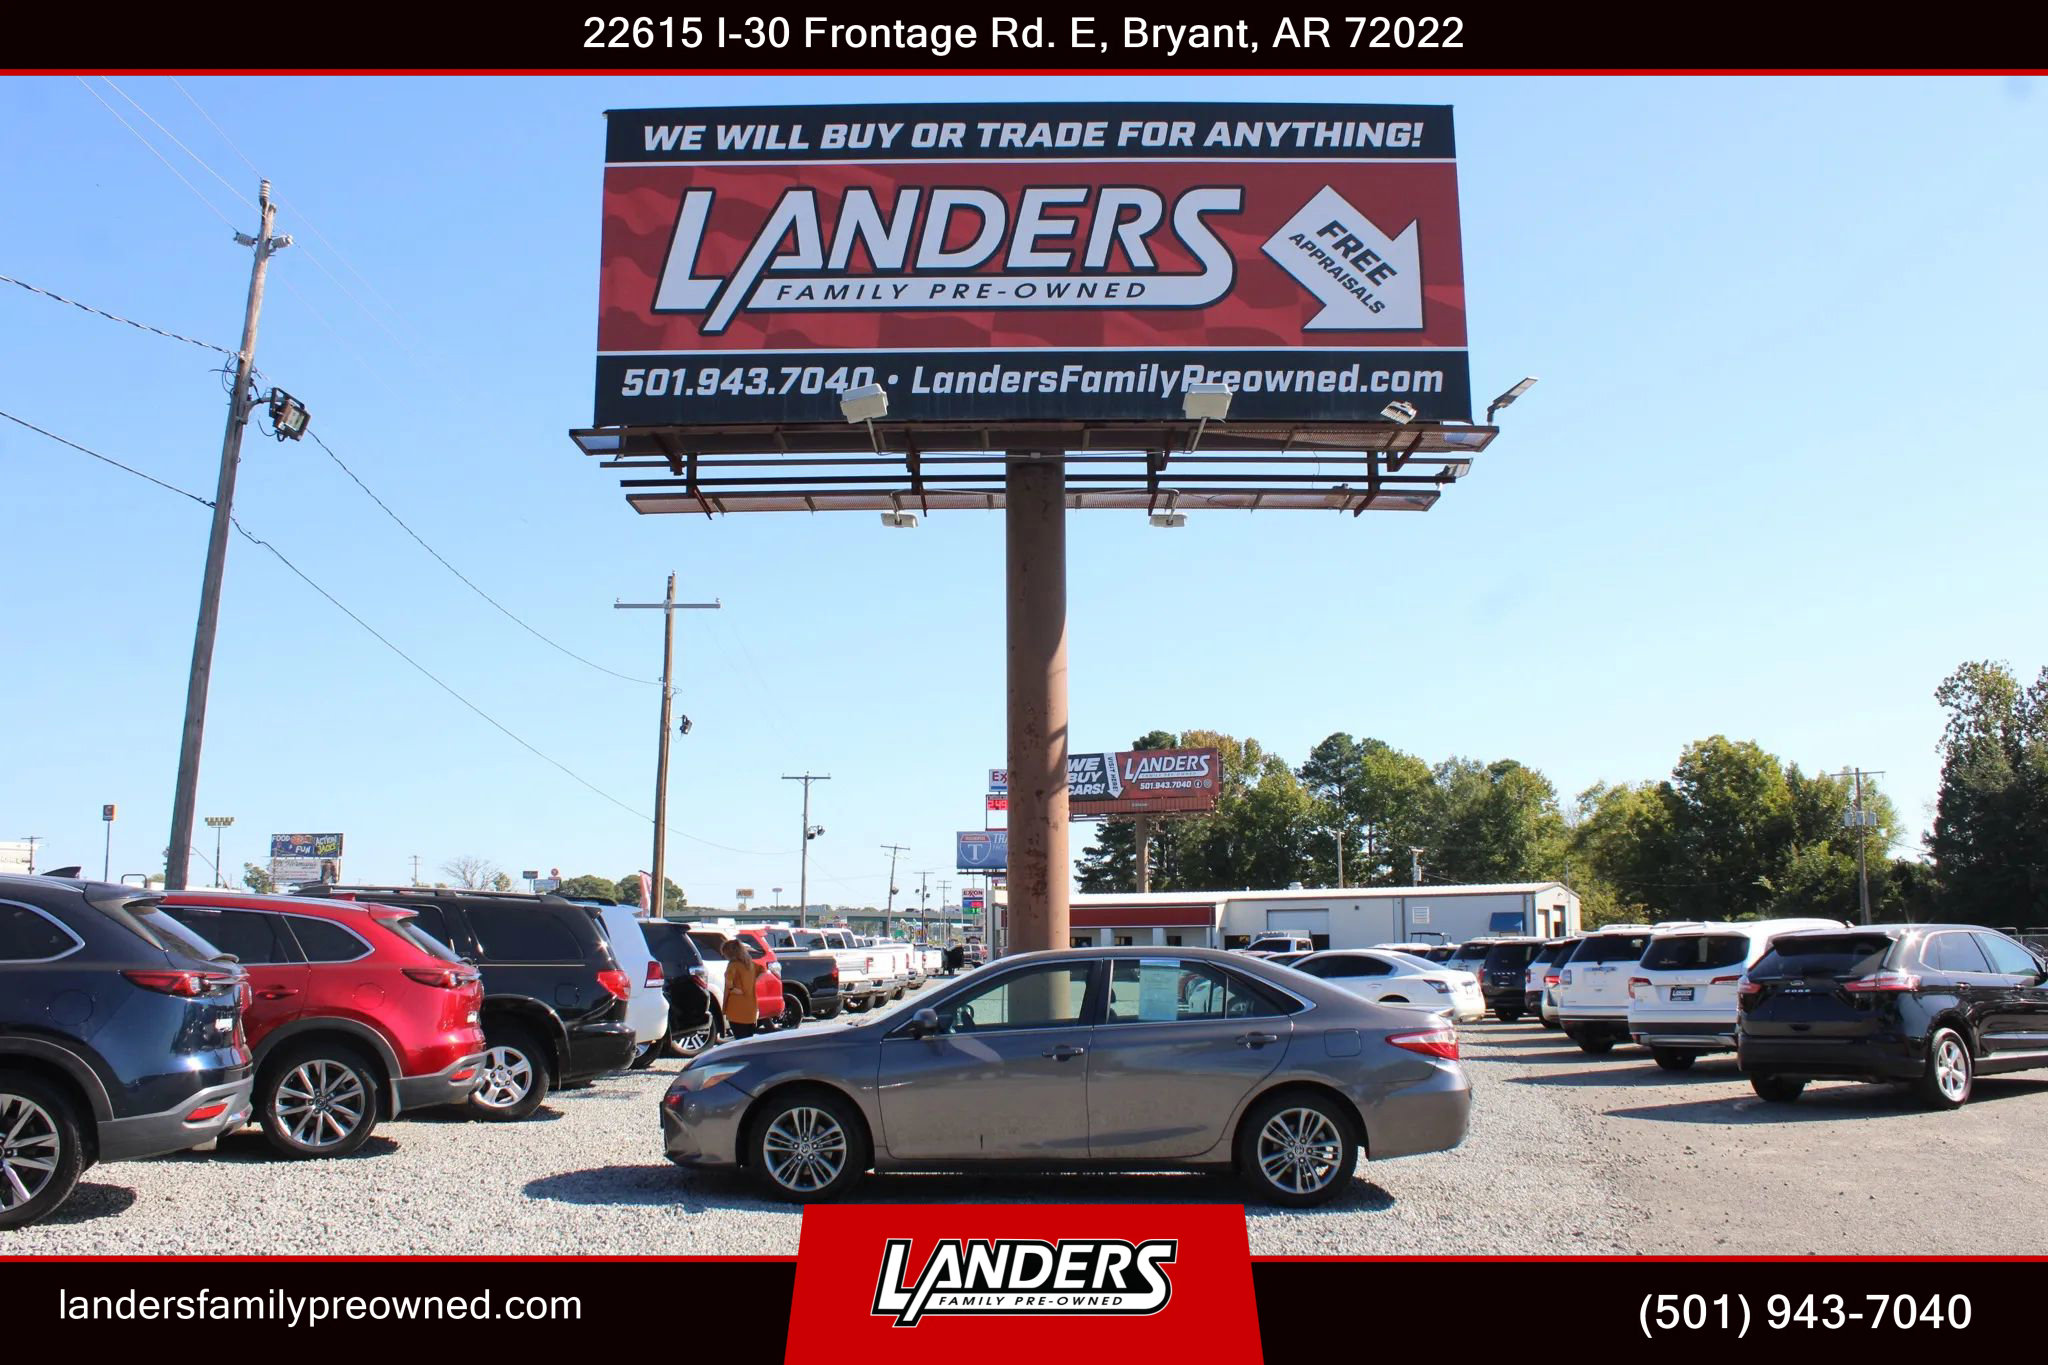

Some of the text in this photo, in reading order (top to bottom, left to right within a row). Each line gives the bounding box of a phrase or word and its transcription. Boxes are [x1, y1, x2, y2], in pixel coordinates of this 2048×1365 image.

[644, 121, 1425, 151] WE WILL BUY OR TRADE FOR ANYTHING!
[651, 185, 1244, 335] LANDERS
[1315, 219, 1398, 287] FREE
[1288, 233, 1386, 314] APPRAISALS
[776, 282, 1146, 301] FAMILY PRE-OWNED
[621, 363, 1444, 399] 501.943.7040 LandersFamilyPreowned.com
[1068, 754, 1210, 784] WE LANDERS
[1068, 771, 1103, 784] BUY
[1140, 780, 1191, 790] 501.943.7040
[963, 890, 983, 898] EXXON
